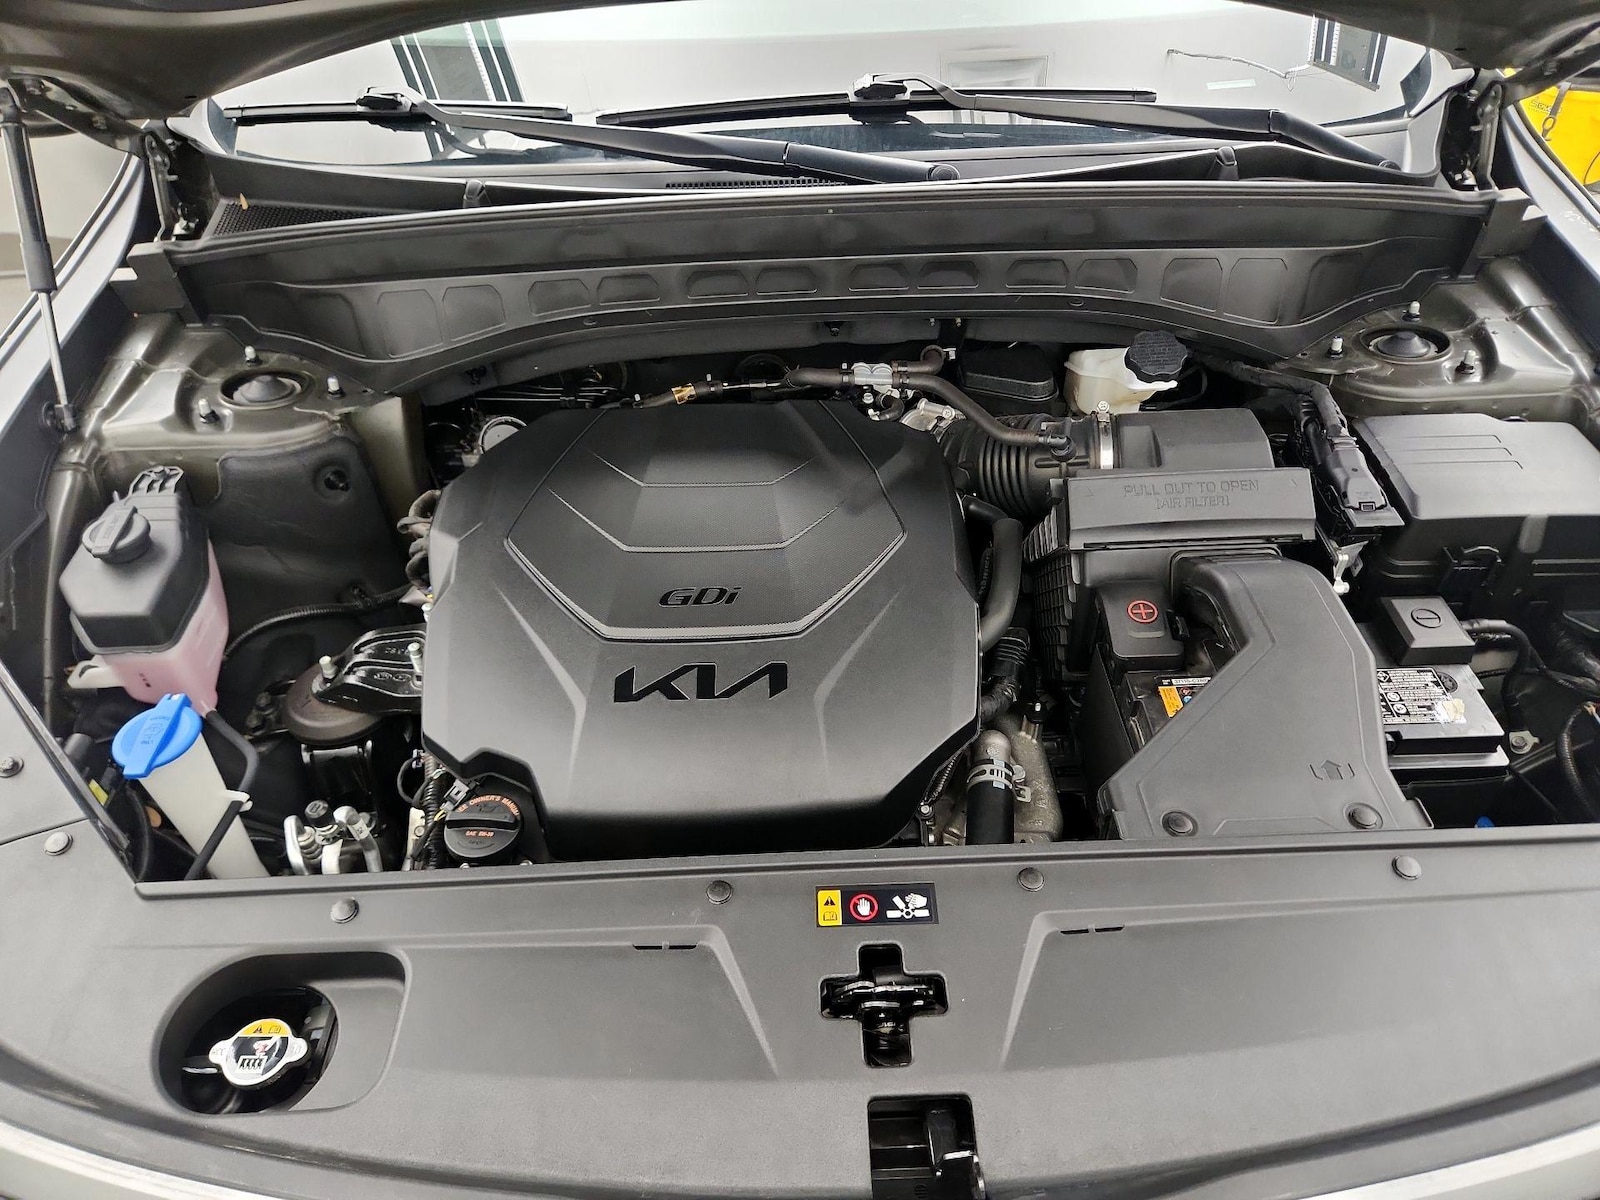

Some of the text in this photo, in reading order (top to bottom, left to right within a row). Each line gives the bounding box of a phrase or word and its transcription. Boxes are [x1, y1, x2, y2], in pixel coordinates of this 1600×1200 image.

[1123, 479, 1259, 497] PULL OUT TO OPEN
[658, 587, 742, 608] GDi
[614, 661, 788, 702] KIA
[469, 795, 502, 805] OWNER'S
[501, 797, 520, 816] MANUAL
